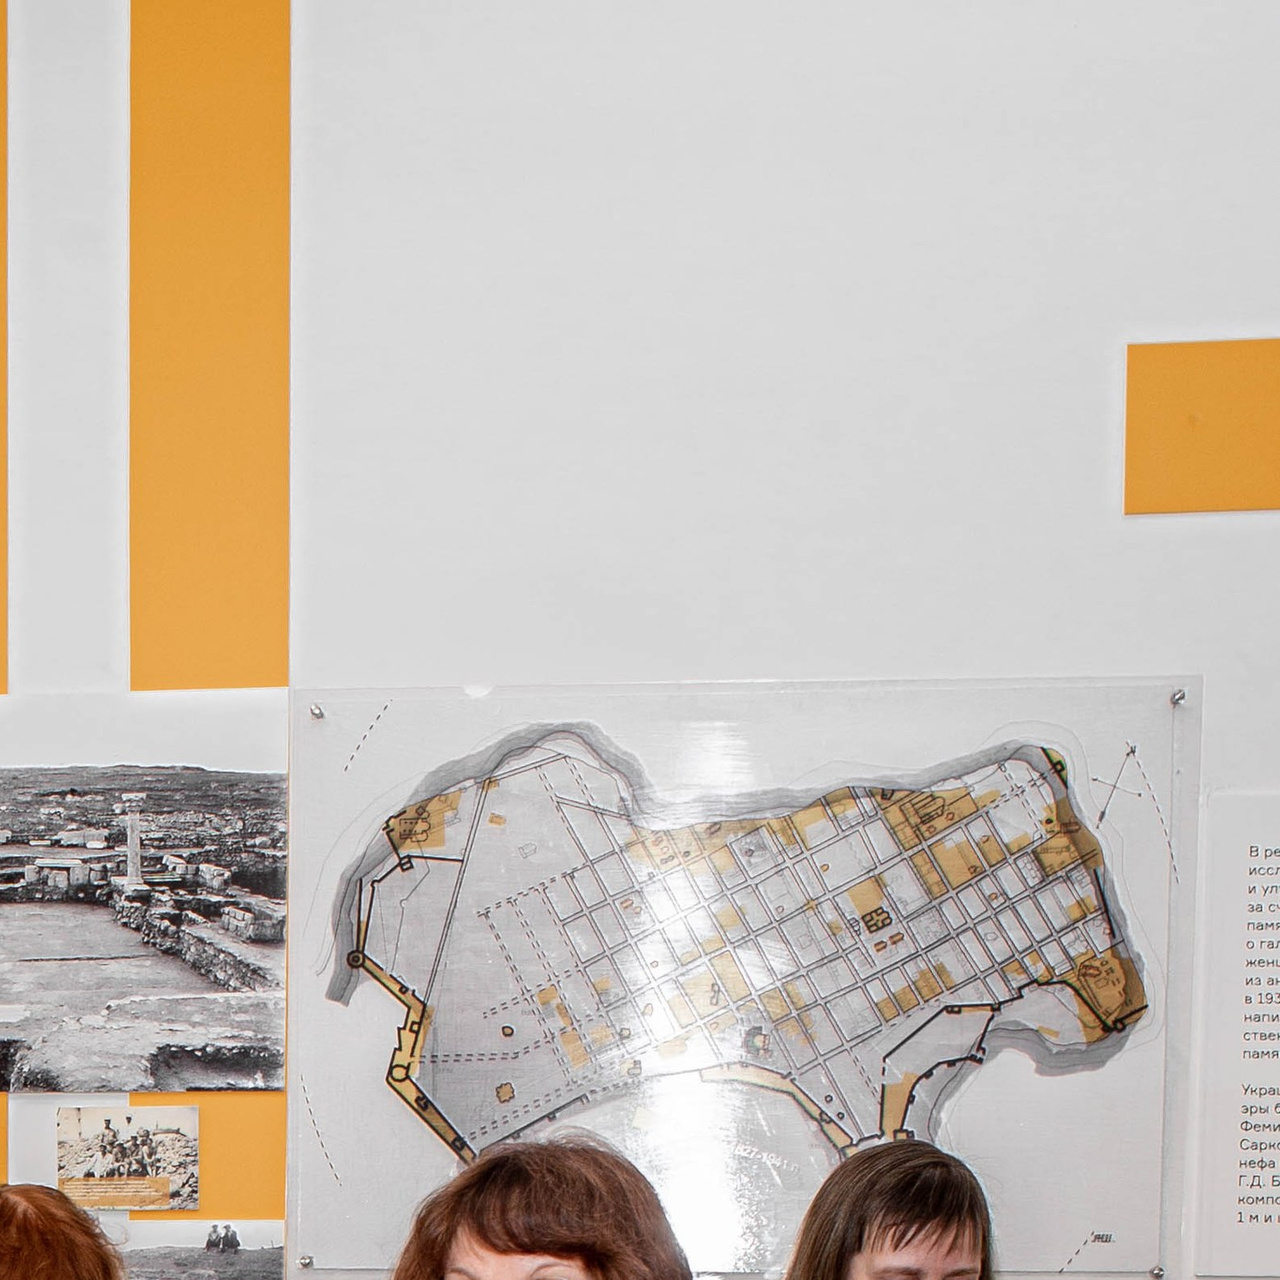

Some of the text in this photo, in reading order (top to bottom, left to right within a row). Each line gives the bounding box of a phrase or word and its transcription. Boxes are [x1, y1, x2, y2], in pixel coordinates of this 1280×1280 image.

[1249, 846, 1259, 857] В
[1248, 885, 1257, 894] и
[1247, 904, 1263, 912] за
[1246, 941, 1254, 950] о
[1245, 977, 1262, 986] из
[1245, 996, 1252, 1004] в
[1241, 1105, 1270, 1116] эры
[1239, 1157, 1276, 1170] нефа
